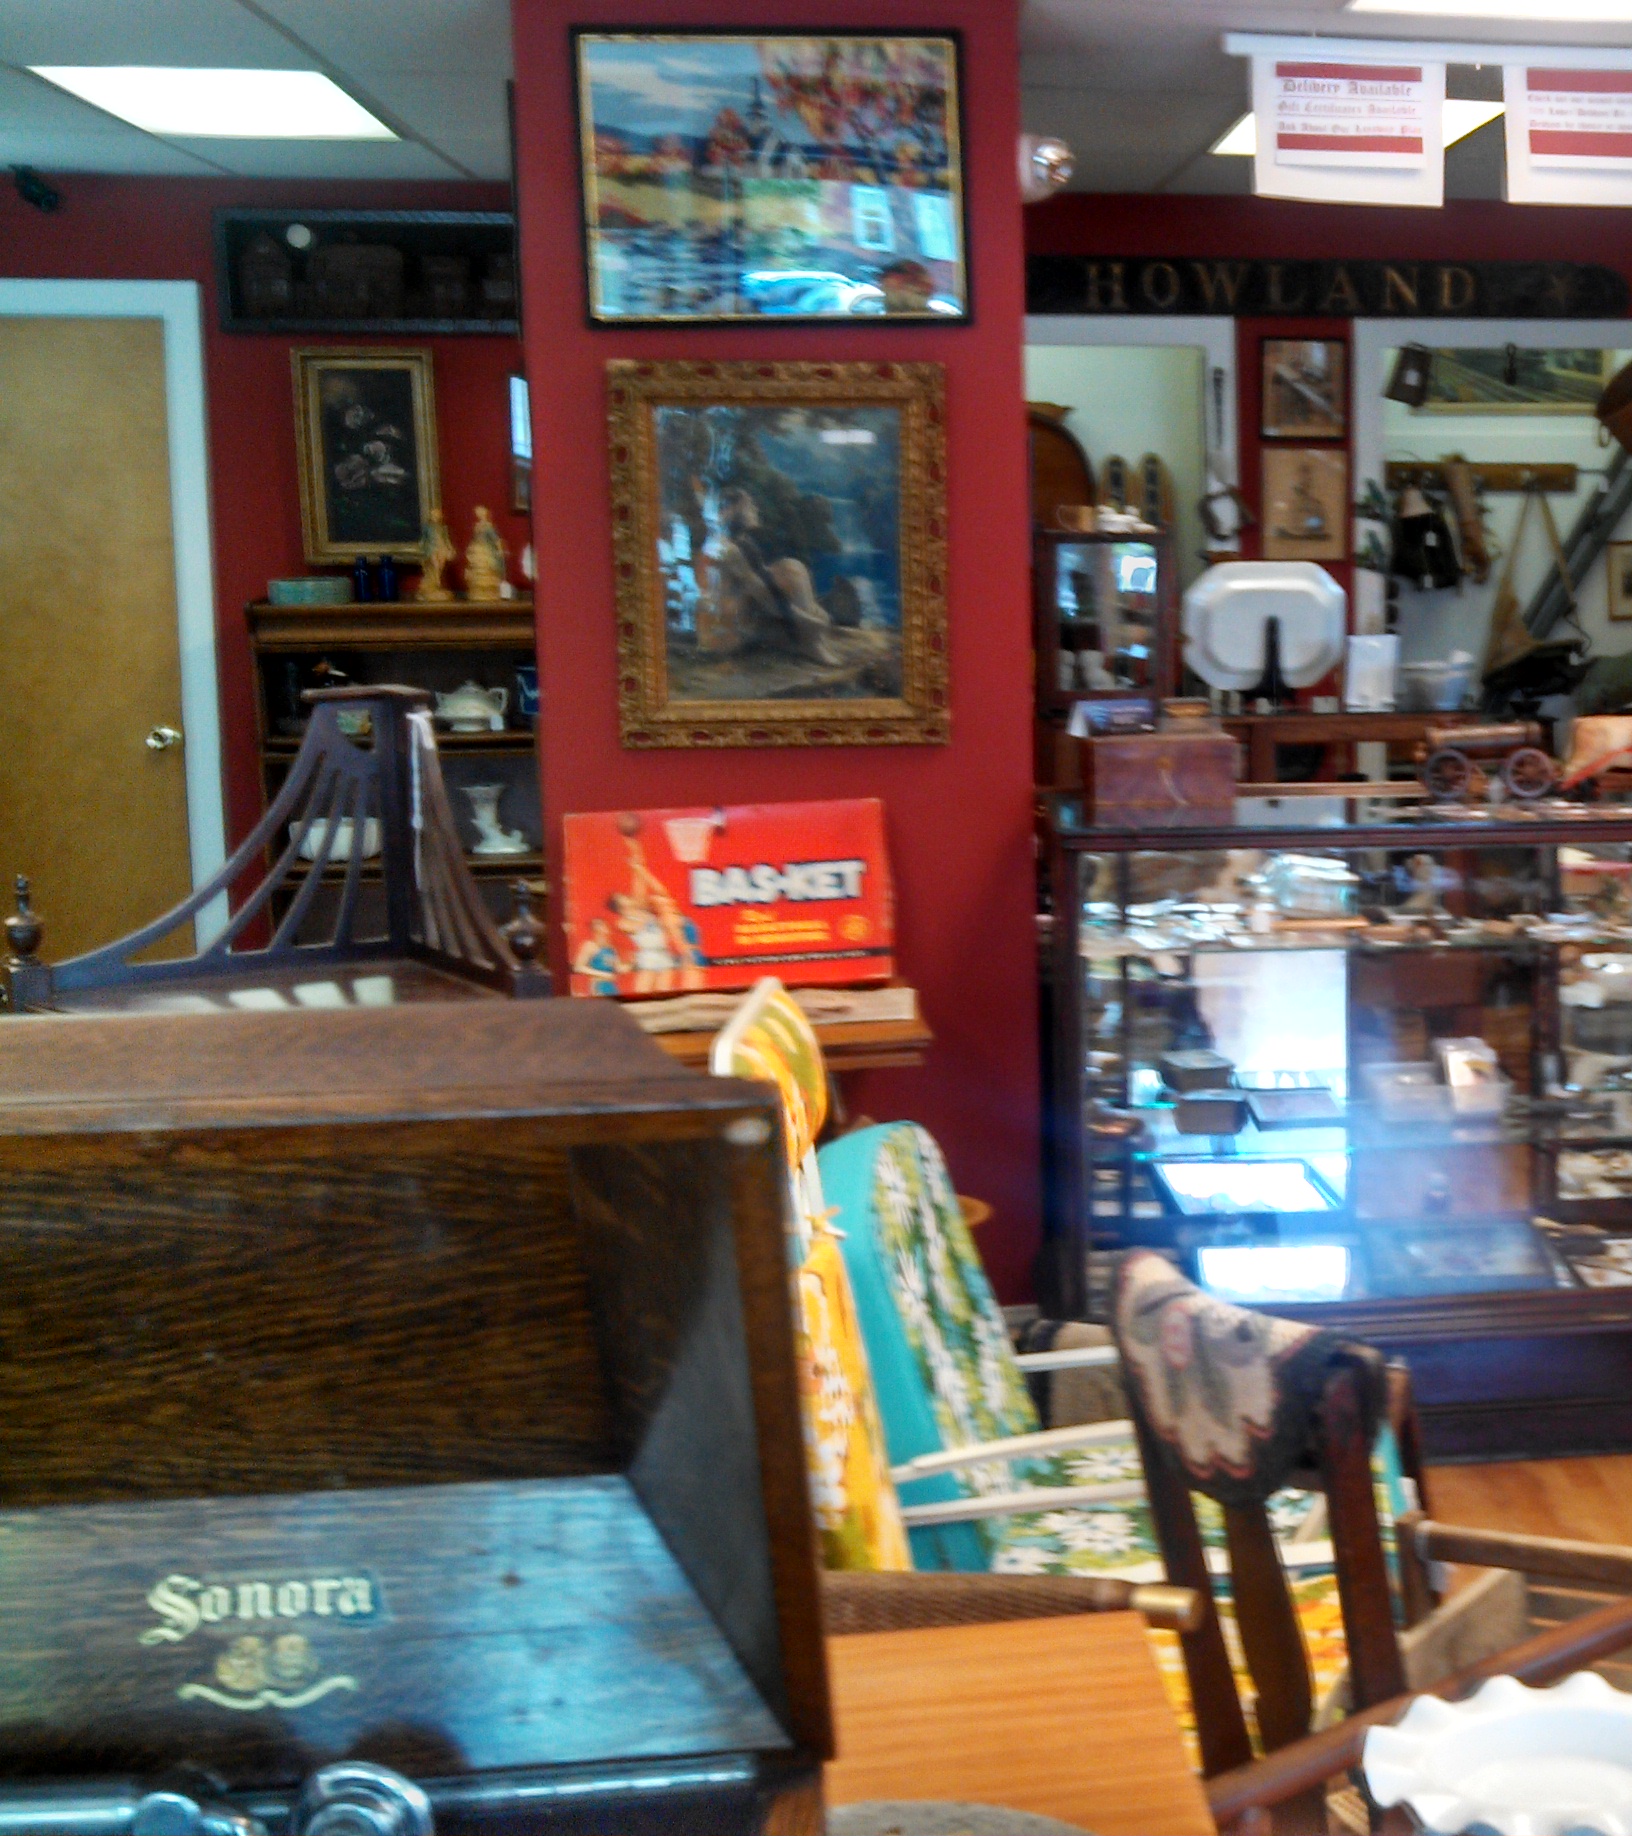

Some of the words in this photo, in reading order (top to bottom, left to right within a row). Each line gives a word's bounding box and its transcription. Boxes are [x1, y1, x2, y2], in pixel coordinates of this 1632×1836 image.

[1283, 79, 1340, 94] Delivery
[1347, 81, 1412, 96] Available
[1086, 262, 1477, 310] HOWLAND
[138, 1573, 375, 1646] Sonora
